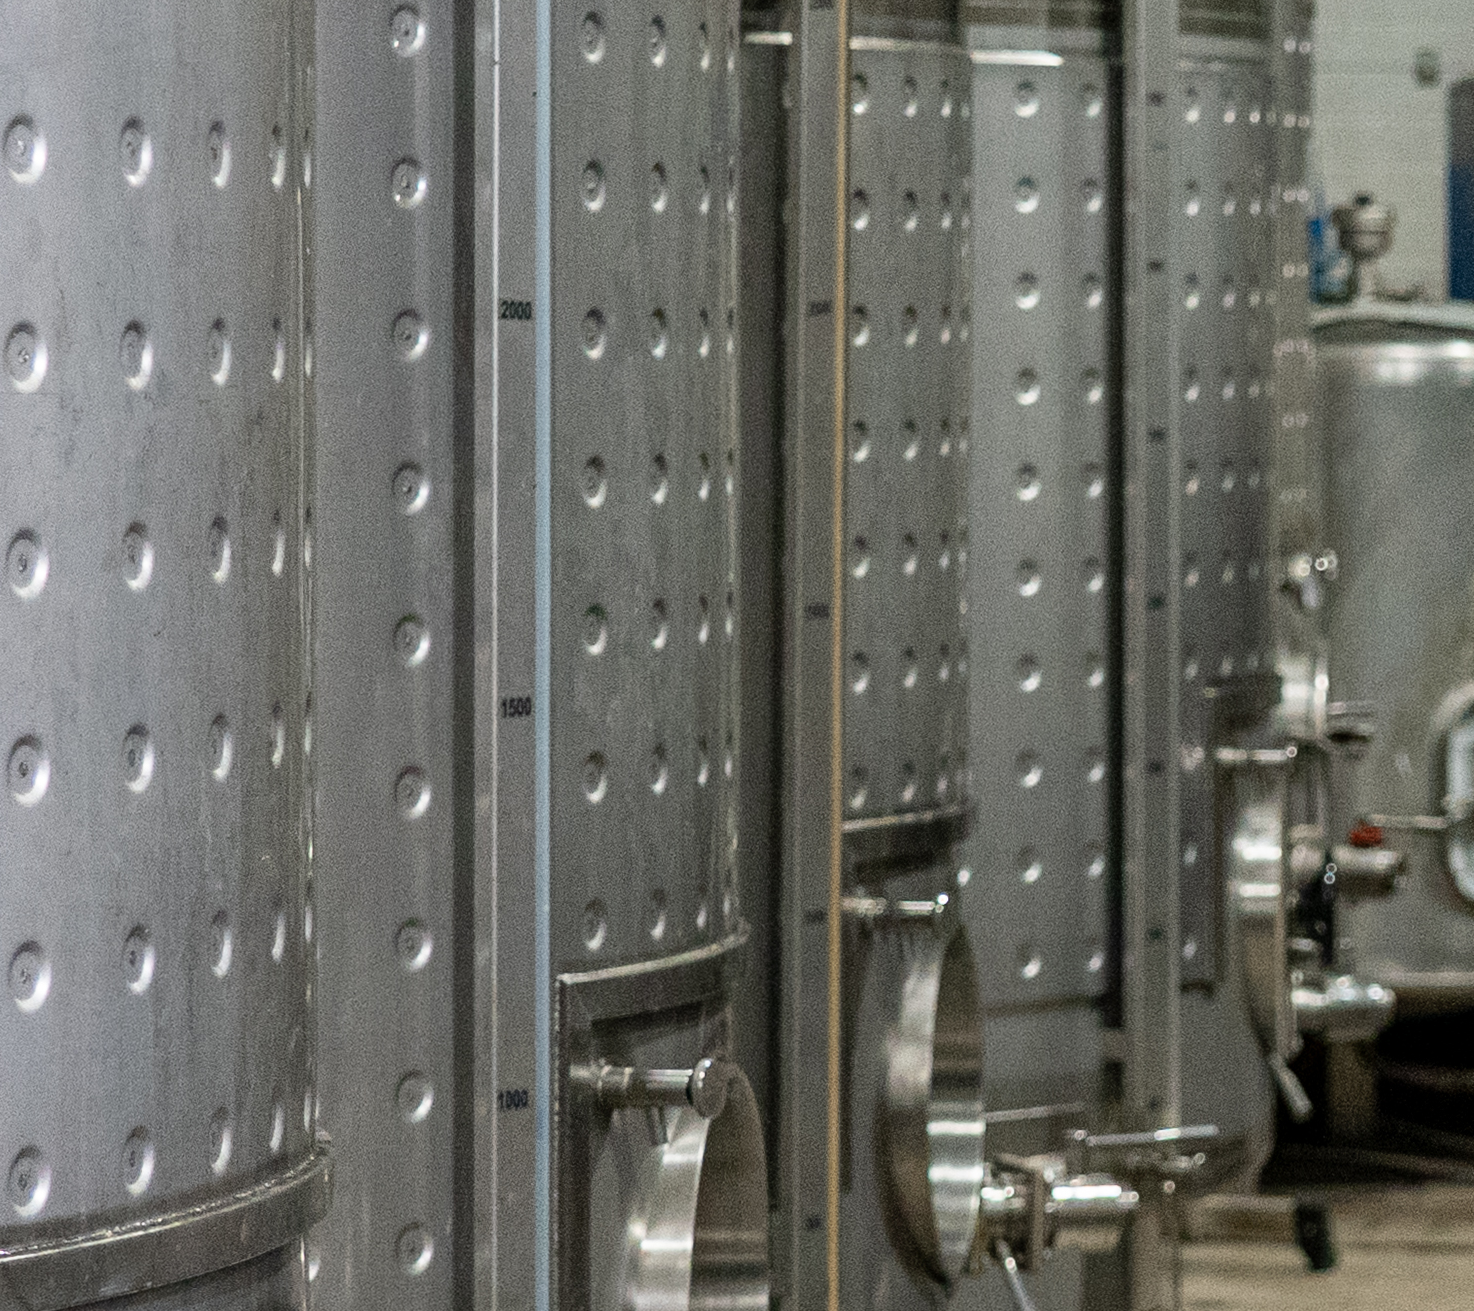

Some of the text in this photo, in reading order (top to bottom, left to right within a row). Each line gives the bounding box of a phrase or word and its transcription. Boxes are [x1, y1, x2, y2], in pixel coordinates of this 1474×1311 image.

[500, 300, 532, 321] 2000
[502, 696, 532, 718] 1500
[498, 1090, 528, 1110] 1000
